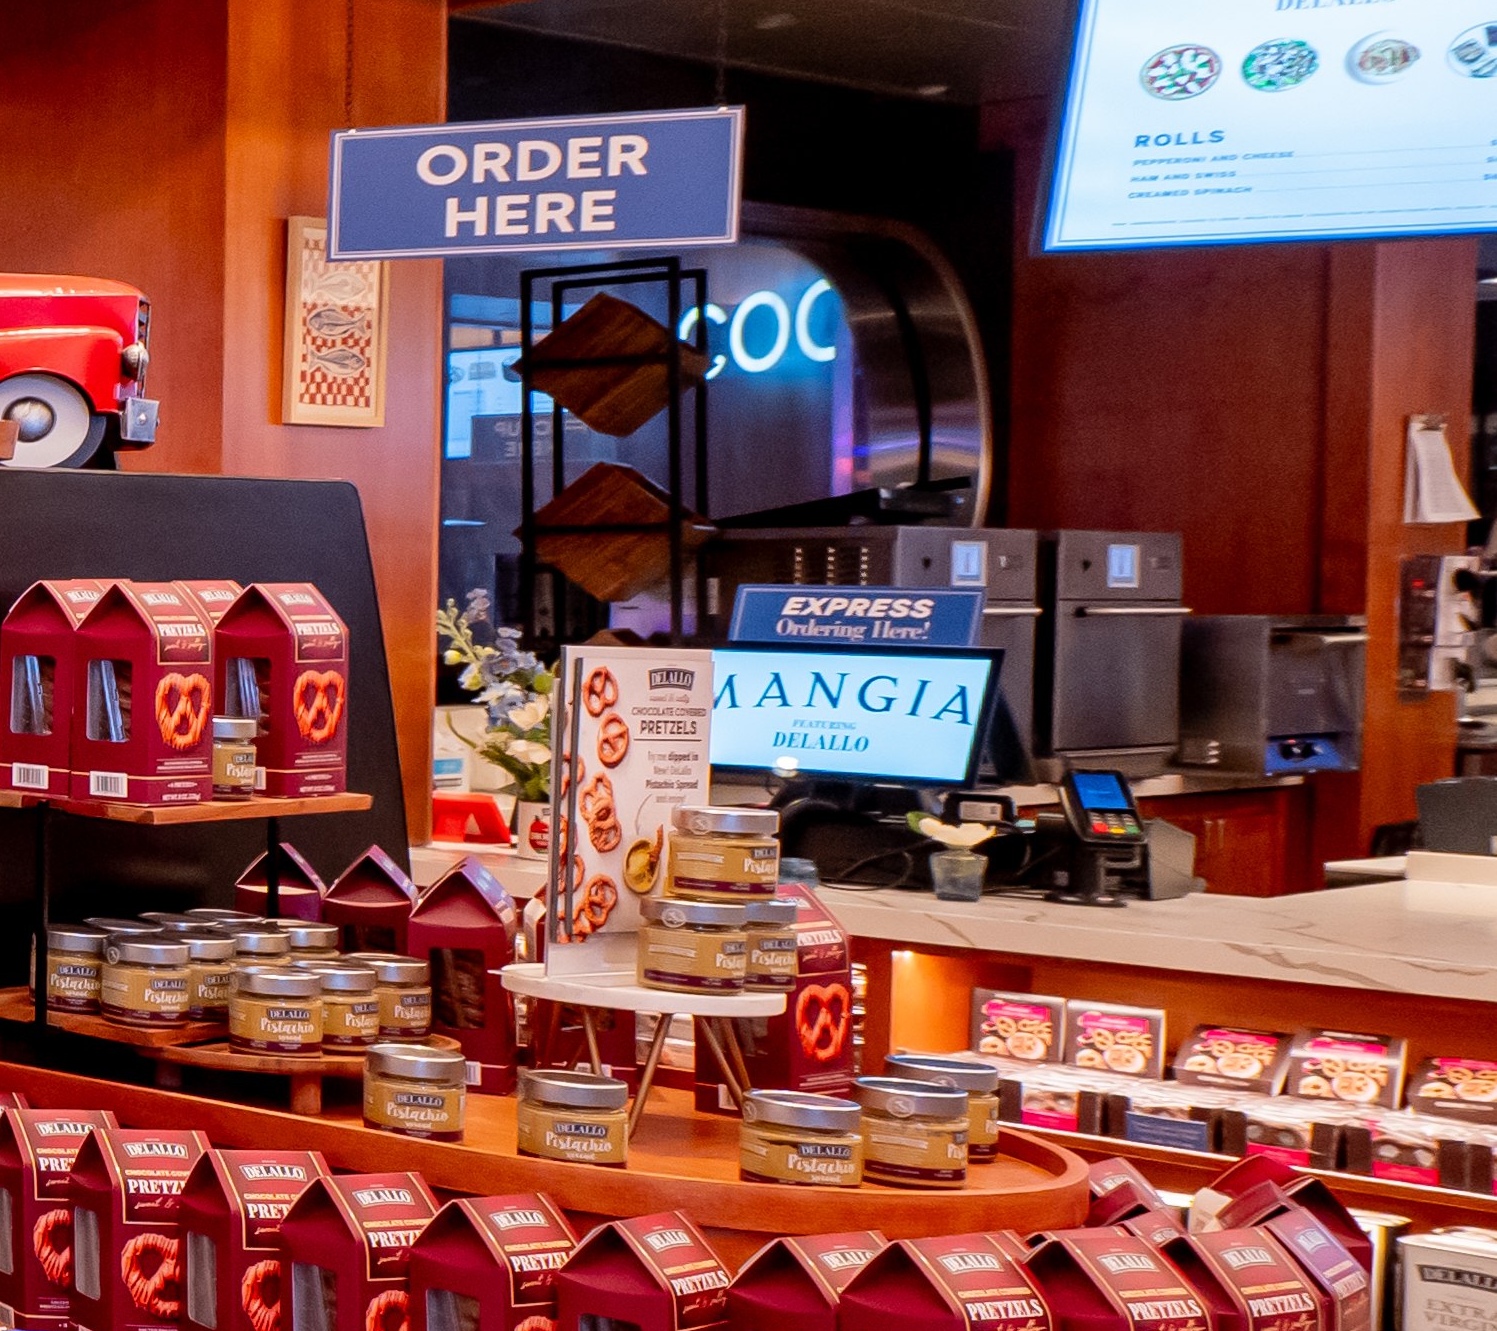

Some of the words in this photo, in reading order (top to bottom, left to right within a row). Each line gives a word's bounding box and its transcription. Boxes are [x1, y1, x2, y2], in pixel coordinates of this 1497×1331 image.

[1134, 130, 1226, 148] ROLLS
[416, 134, 649, 187] ORDER
[1133, 155, 1207, 167] PEPPERONI
[1211, 154, 1239, 164] AND
[1242, 151, 1294, 162] CHEESE
[1130, 174, 1159, 182] HAM
[1163, 172, 1190, 181] AND
[1192, 171, 1236, 180] SWISS
[1128, 189, 1189, 200] CREAMED
[1193, 186, 1252, 196] SPINACH
[445, 190, 617, 237] HERE
[781, 597, 936, 620] EXPRESS
[775, 617, 871, 644] Ordering
[877, 617, 931, 641] Here!
[651, 670, 693, 688] DELALLO
[712, 669, 974, 727] MANGIA
[632, 707, 674, 716] CHOCOLATE
[675, 708, 707, 717] COVERED
[640, 720, 697, 735] PRETZELS
[792, 718, 856, 731] FEATURING
[668, 753, 690, 762] dipped
[691, 753, 698, 761] in
[646, 779, 674, 789] Pistachio
[675, 780, 698, 791] Spread
[385, 1104, 449, 1124] Pistachio
[125, 1169, 170, 1177] CHOCOLATE
[240, 1164, 307, 1181] DELALLO
[787, 1157, 856, 1178] Pistachio
[644, 1229, 695, 1249] DELALLO
[510, 1251, 572, 1272] PRETZEL
[937, 1252, 1006, 1274] DELALLO
[1219, 1246, 1277, 1270] DELALLO
[672, 1269, 730, 1296] PRETZELS
[1128, 1298, 1202, 1321] PRETZELS
